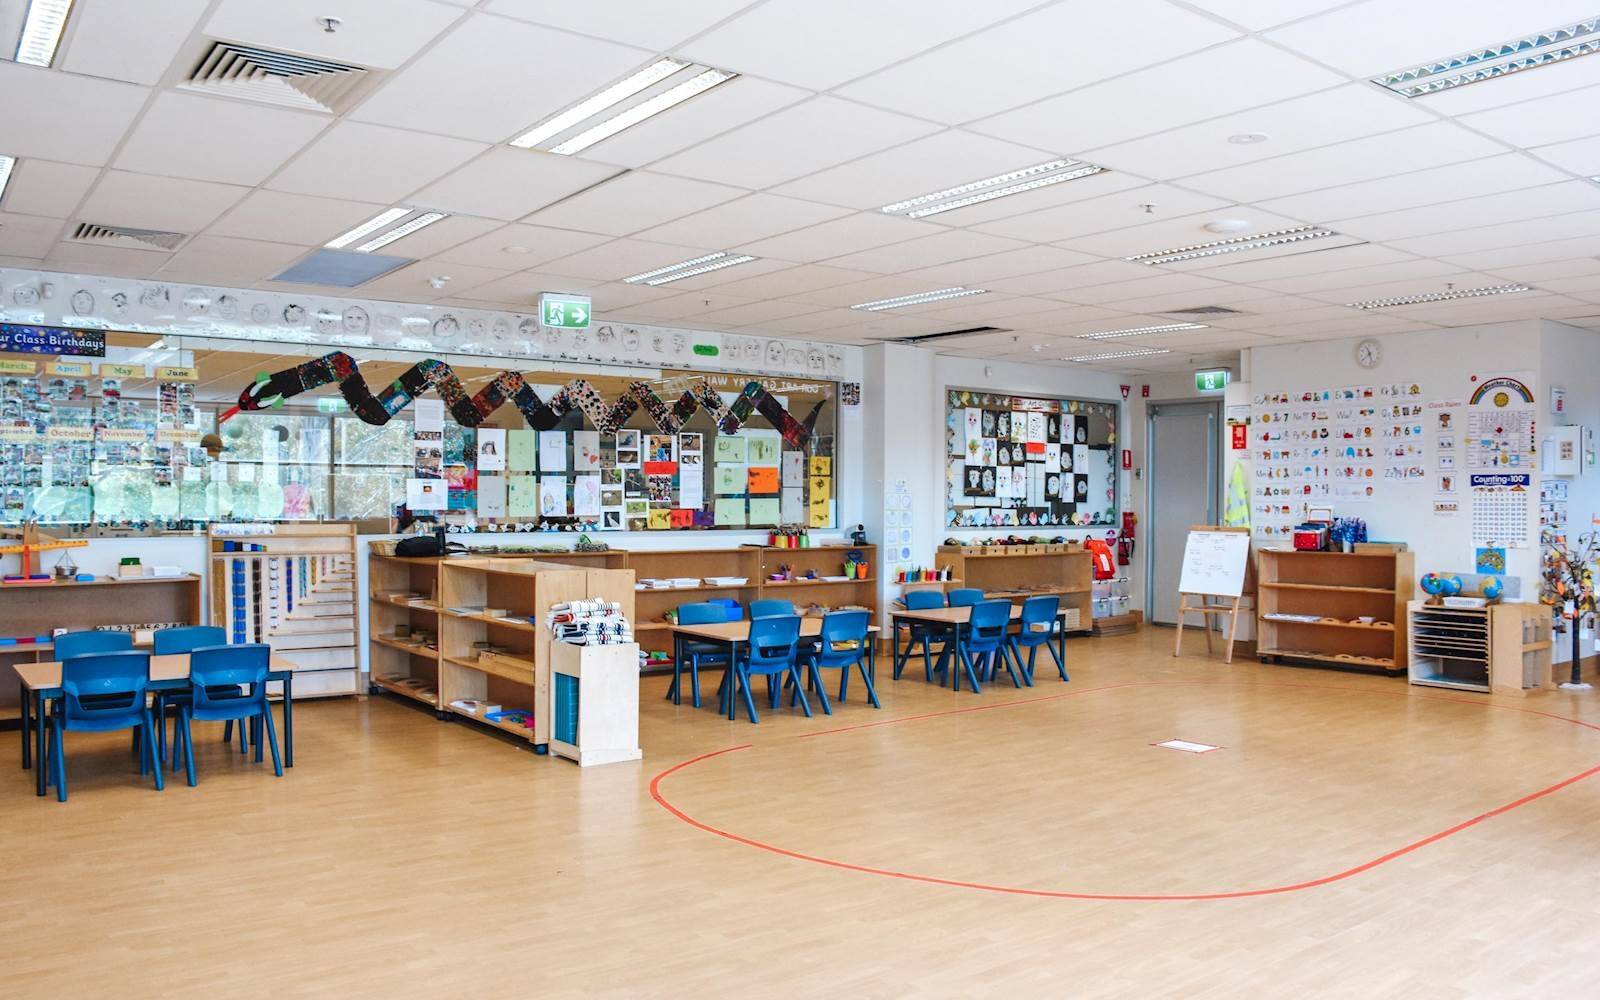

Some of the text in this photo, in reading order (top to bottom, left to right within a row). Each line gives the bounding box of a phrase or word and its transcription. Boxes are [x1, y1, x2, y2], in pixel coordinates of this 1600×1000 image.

[14, 333, 46, 345] Class
[49, 335, 105, 350] Birthdays
[56, 365, 82, 373] April
[114, 367, 133, 376] May
[167, 369, 189, 377] June
[50, 429, 91, 438] October
[1473, 475, 1507, 485] Counting
[1510, 475, 1524, 483] 100
